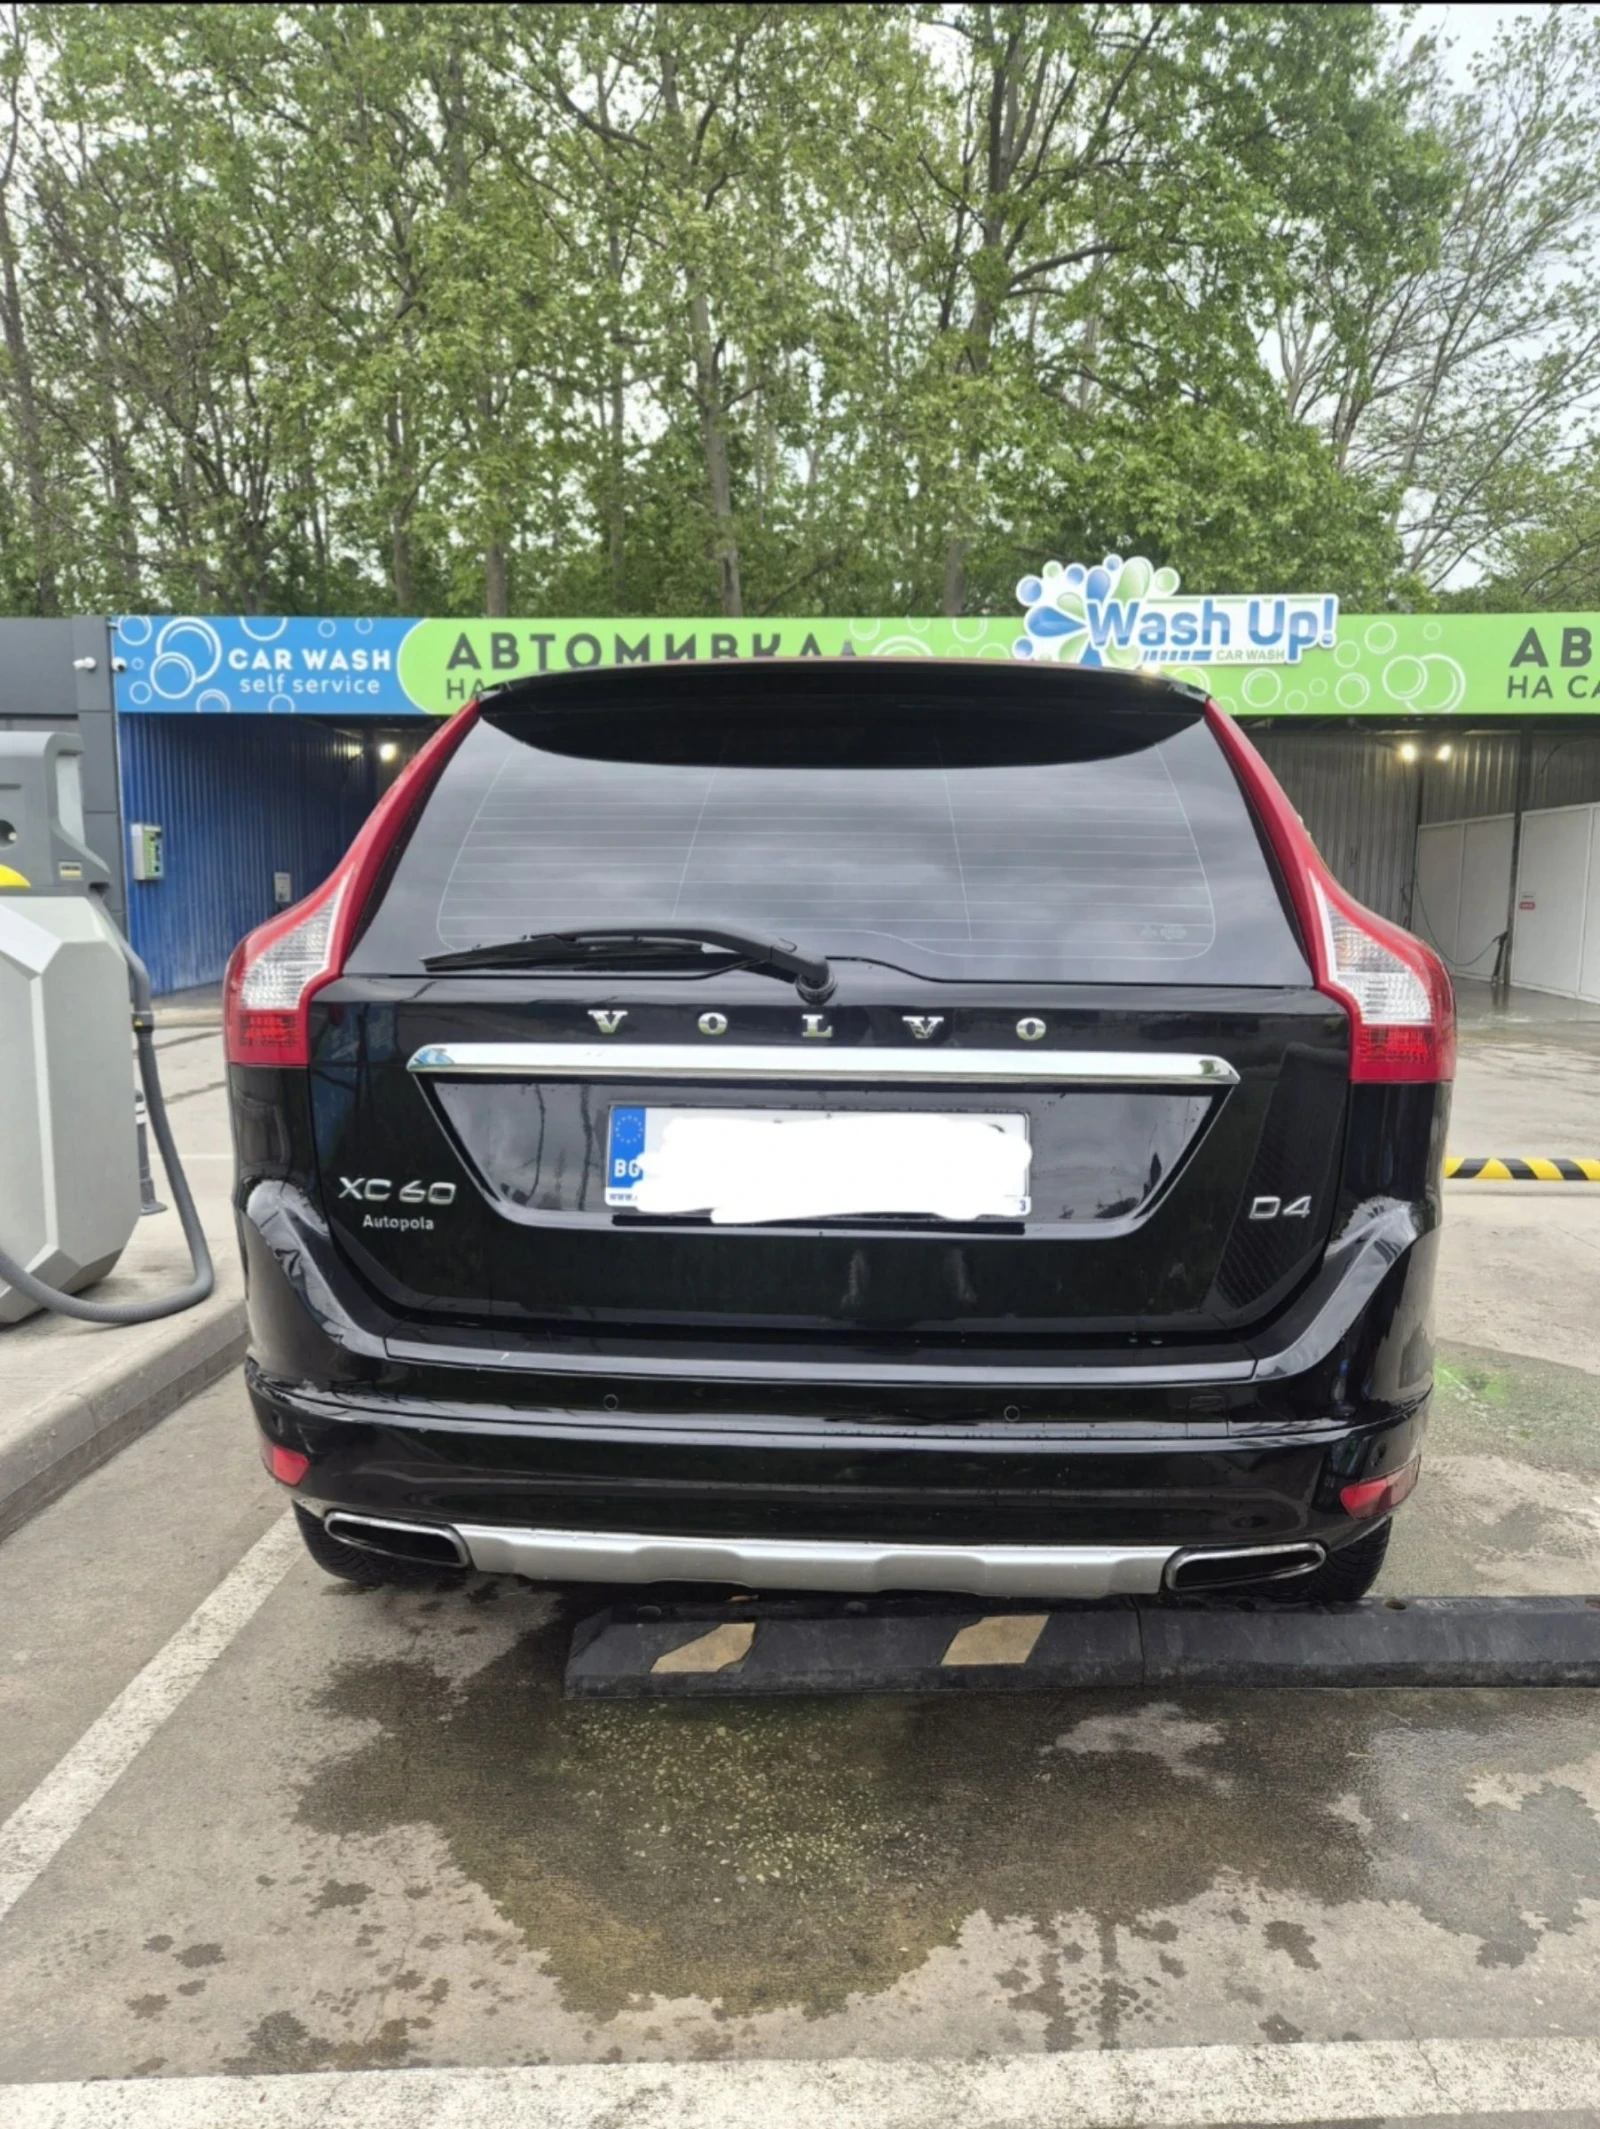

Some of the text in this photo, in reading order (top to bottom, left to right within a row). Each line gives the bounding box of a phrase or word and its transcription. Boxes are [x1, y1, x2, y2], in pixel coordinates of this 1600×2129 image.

[1088, 597, 1335, 661] Wash Up!
[228, 648, 391, 671] CAR WASH
[445, 631, 822, 671] АВТОМИВКА
[1216, 649, 1285, 661] CAR WASH
[239, 674, 380, 694] self service
[446, 678, 484, 700] НА
[1507, 675, 1554, 699] НА
[588, 1010, 1046, 1041] VOLVO
[1249, 1195, 1311, 1219] D4
[362, 1214, 435, 1232] Autopola
